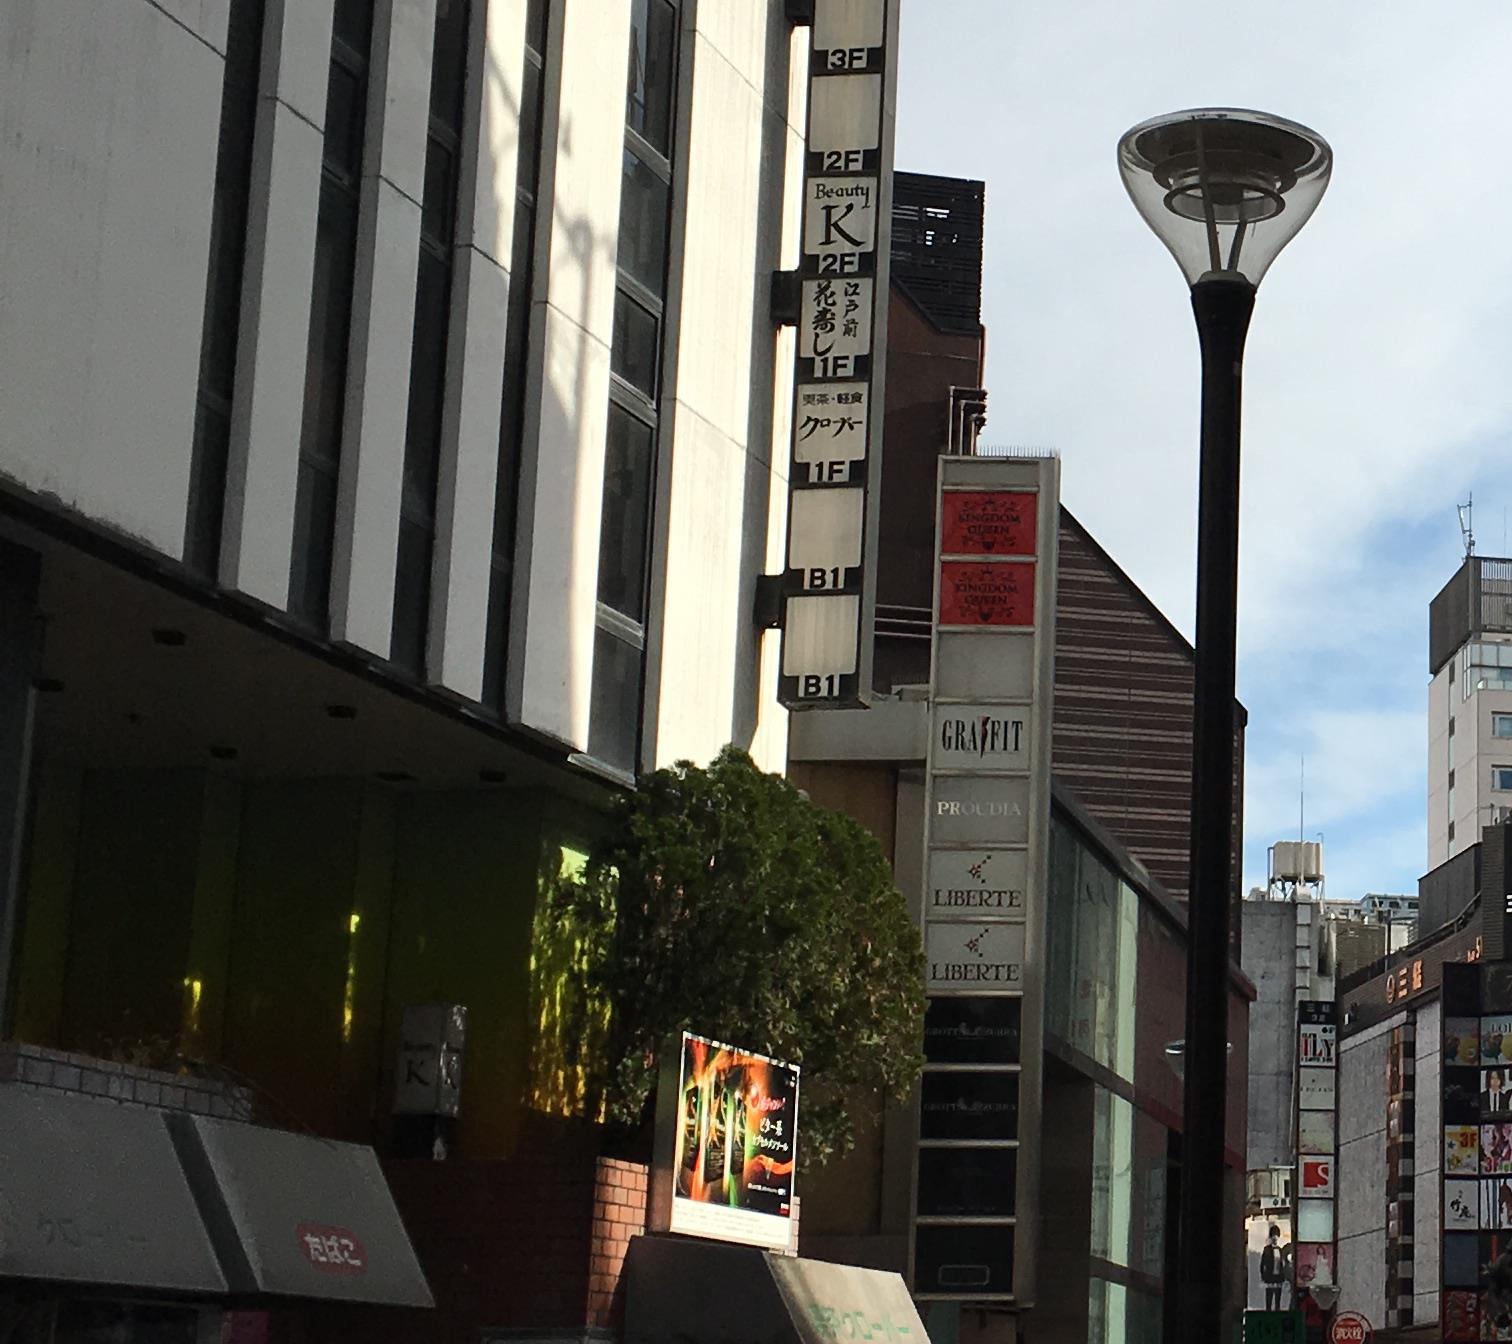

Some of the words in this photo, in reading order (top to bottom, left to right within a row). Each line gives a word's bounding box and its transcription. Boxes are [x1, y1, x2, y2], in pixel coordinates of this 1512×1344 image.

[830, 48, 866, 68] 3F
[824, 151, 862, 171] 2F
[815, 184, 870, 208] Beauty
[819, 204, 866, 247] K
[820, 254, 857, 273] 2F
[843, 282, 860, 337] 江戸前
[820, 357, 849, 377] 1F
[799, 415, 863, 442] クローバー
[815, 461, 845, 482] 1F
[809, 568, 839, 588] B1
[805, 676, 834, 696] B1
[933, 889, 1022, 906] LIBERTE
[931, 963, 1020, 981] LIBERTE
[304, 1233, 362, 1266] たばこ
